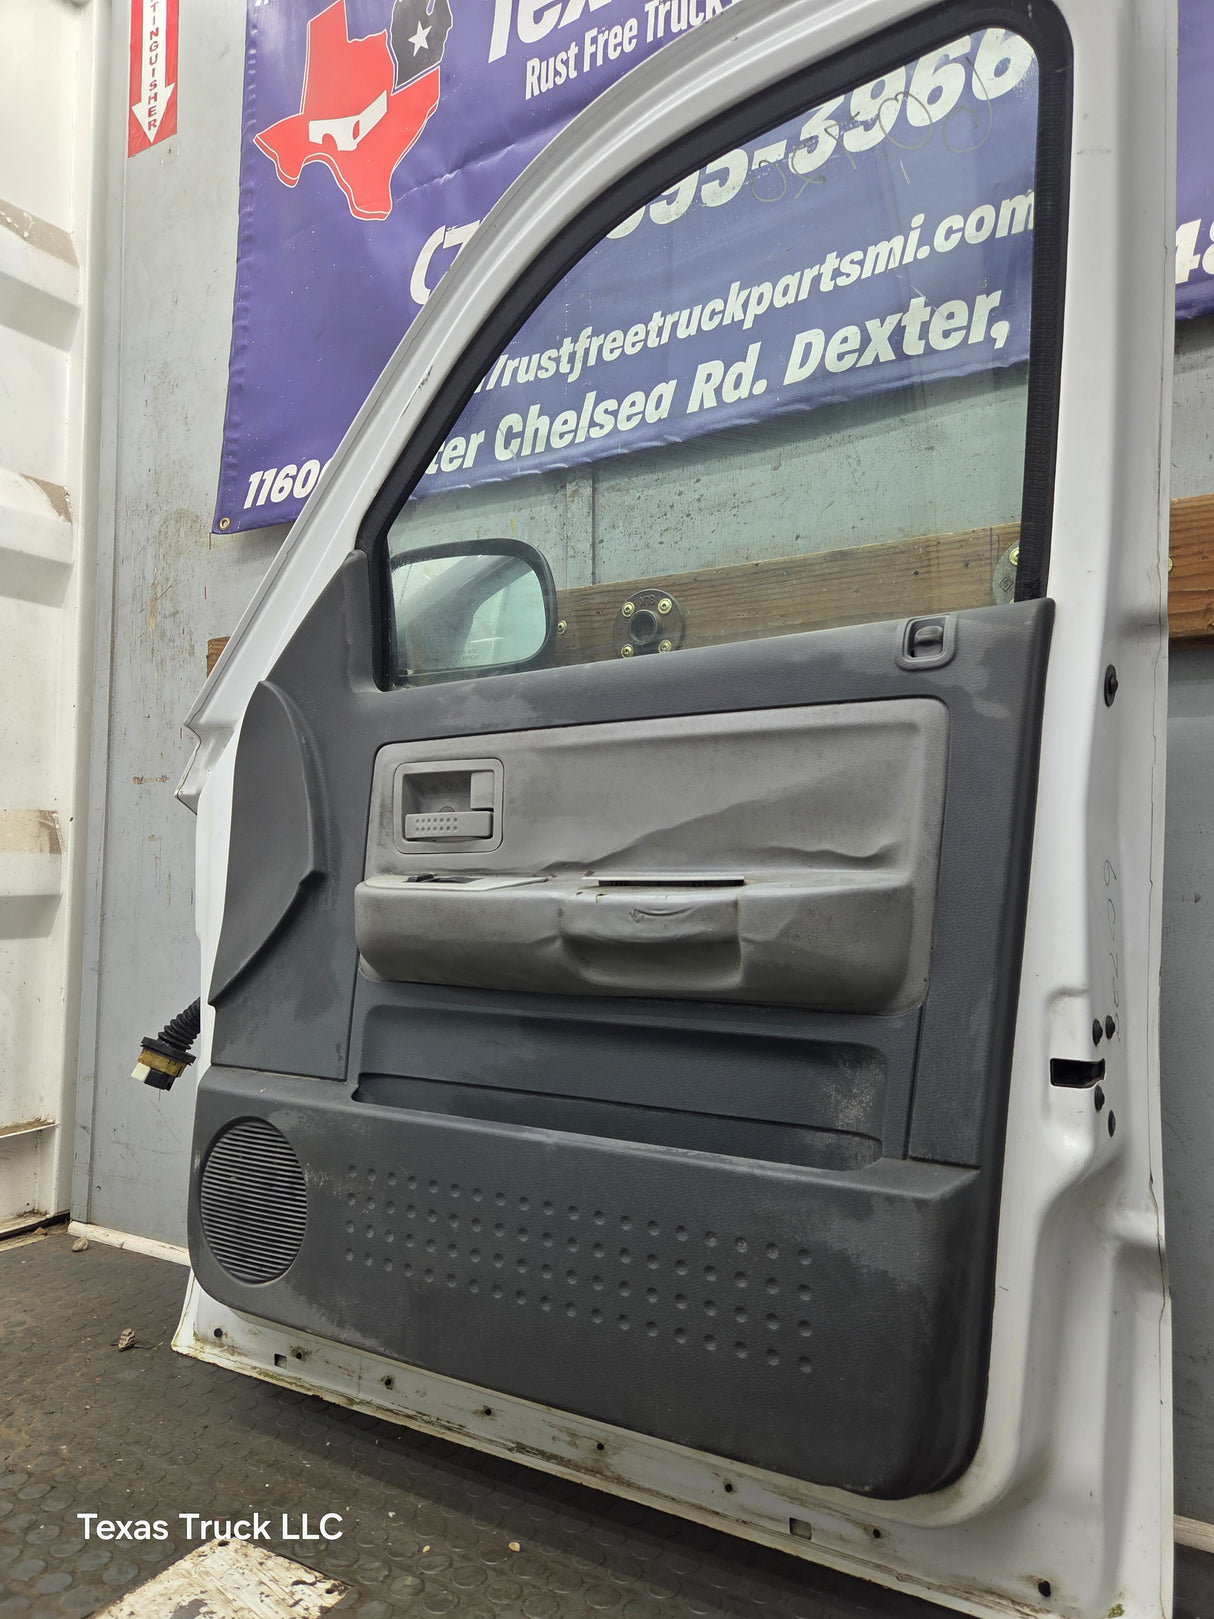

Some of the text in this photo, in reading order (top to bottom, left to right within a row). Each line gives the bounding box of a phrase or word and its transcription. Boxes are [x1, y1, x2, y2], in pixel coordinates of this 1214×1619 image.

[525, 57, 579, 101] Rust
[583, 17, 639, 73] Free
[606, 28, 1035, 240] 95-3966
[243, 459, 333, 510] 1160
[495, 378, 678, 461] Chelsea
[686, 341, 768, 414] Rd.
[783, 289, 1010, 386] Dexter,
